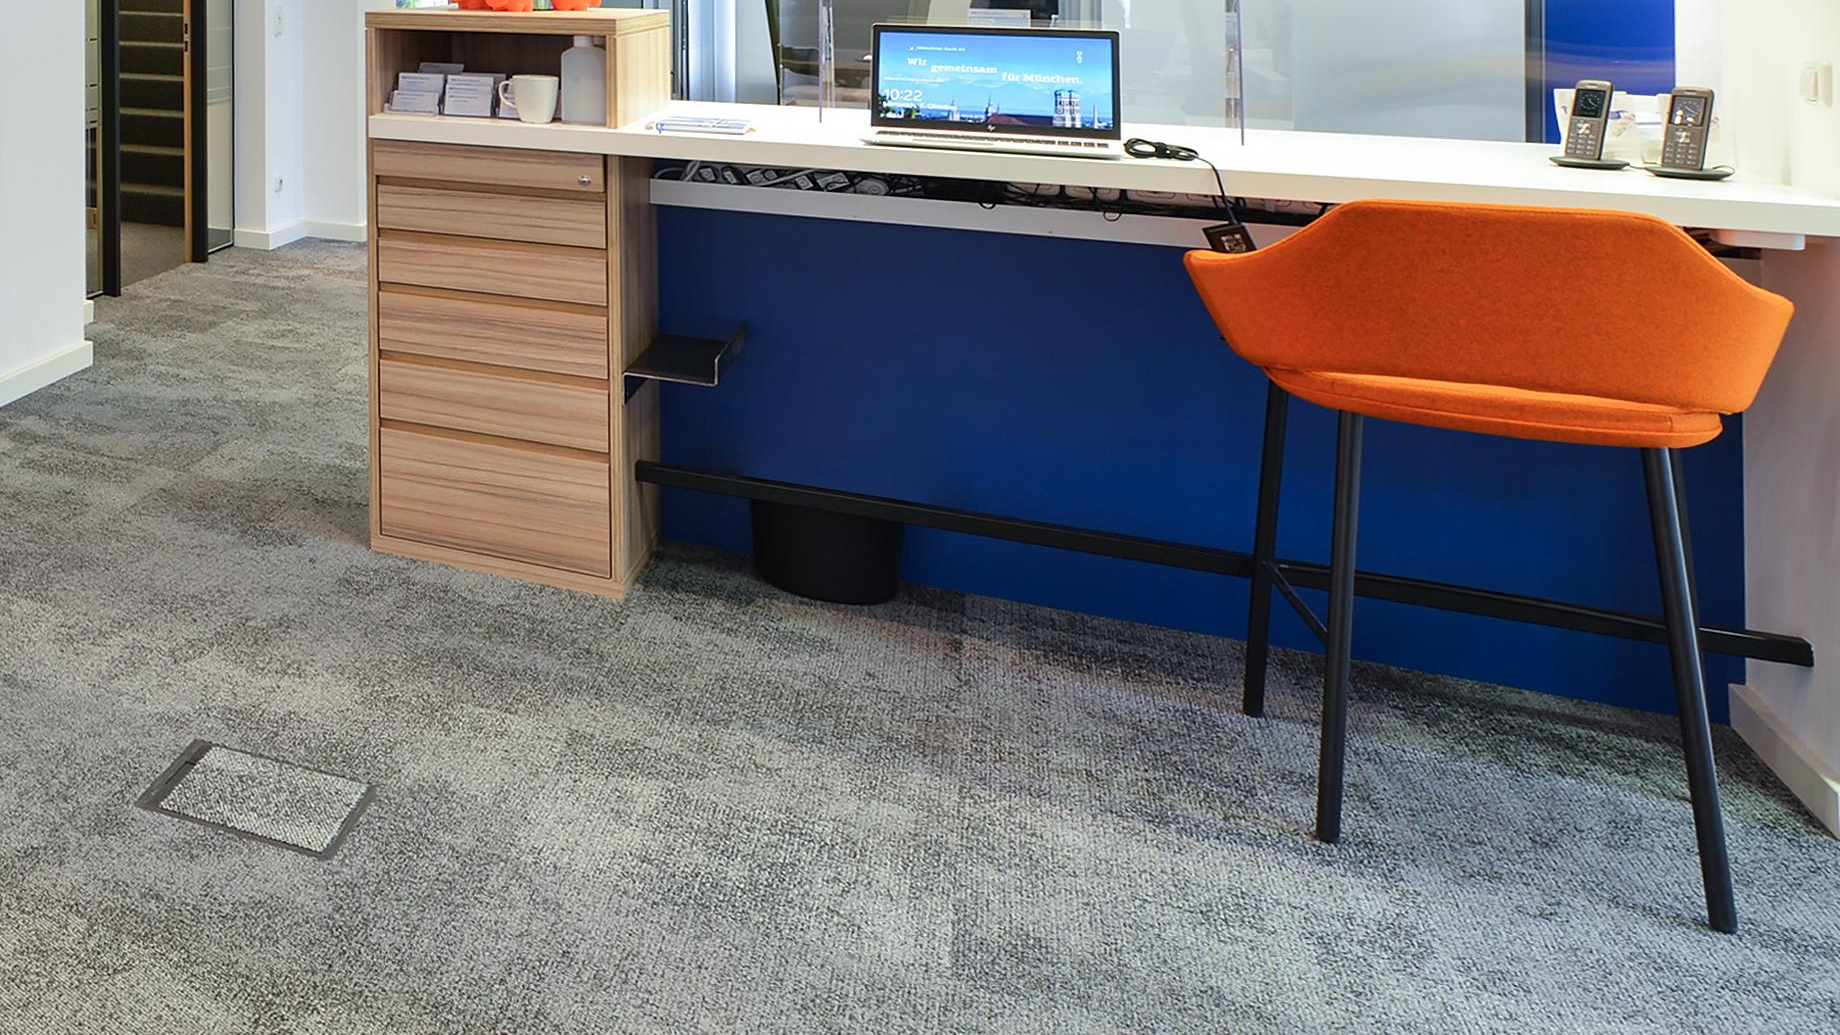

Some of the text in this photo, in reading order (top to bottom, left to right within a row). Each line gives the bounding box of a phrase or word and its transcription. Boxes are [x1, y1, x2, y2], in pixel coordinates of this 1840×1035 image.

[907, 57, 1084, 85] Wir gemeinsam für München.
[884, 89, 923, 102] 10:22
